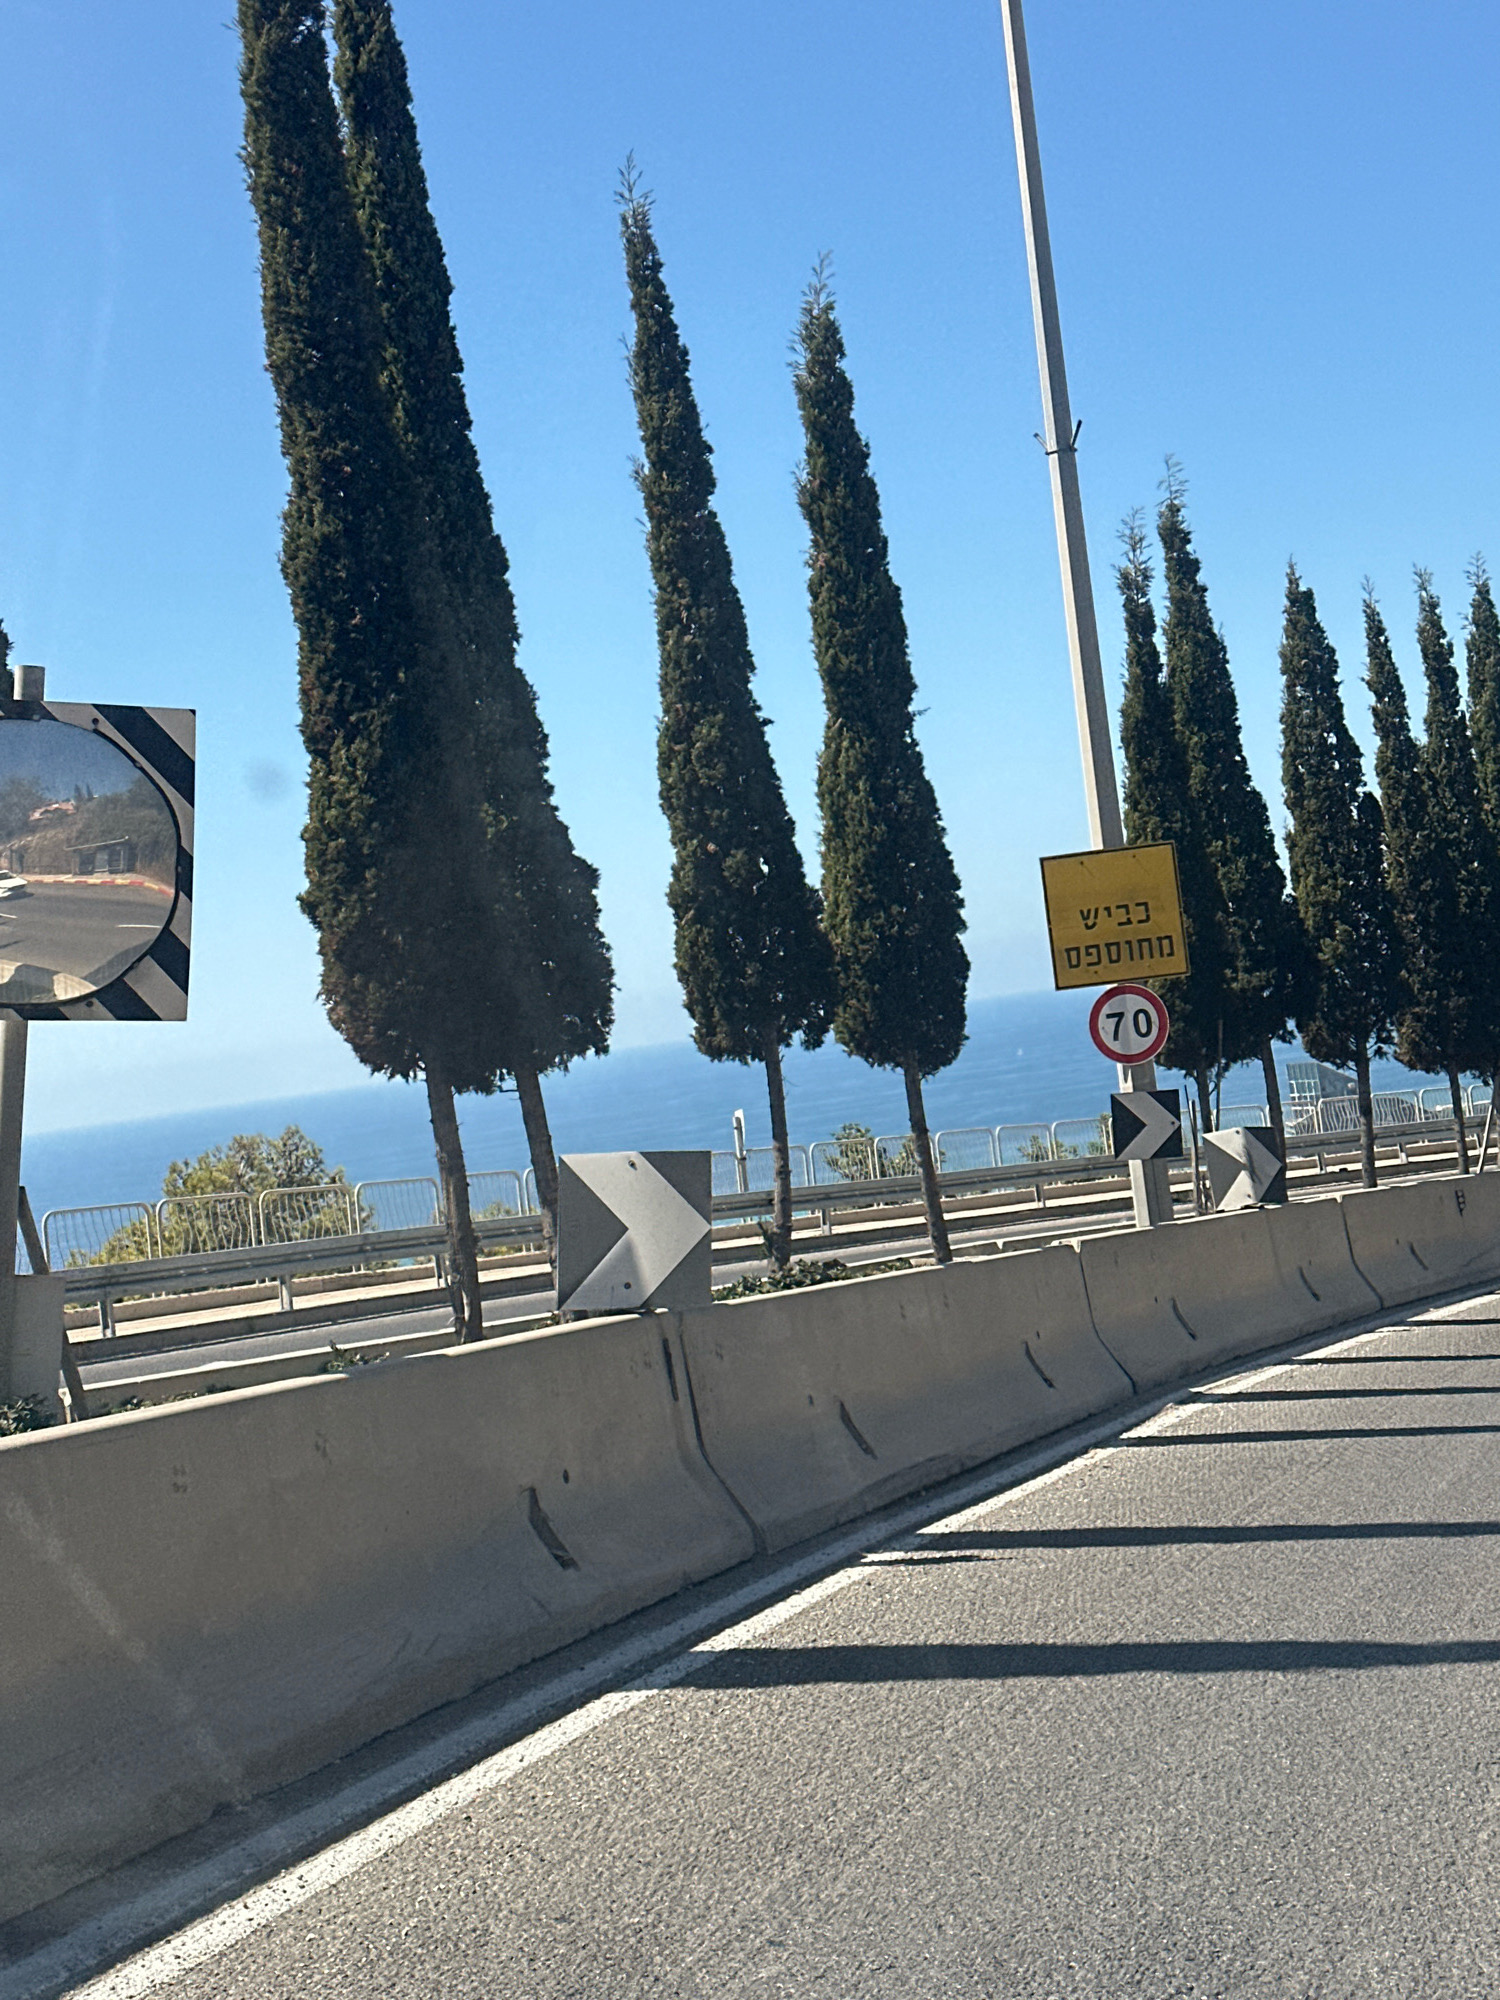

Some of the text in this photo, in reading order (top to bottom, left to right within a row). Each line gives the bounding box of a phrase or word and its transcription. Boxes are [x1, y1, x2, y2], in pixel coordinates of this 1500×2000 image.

[1079, 901, 1151, 930] כביש
[1064, 935, 1175, 969] מחוספס
[1105, 1008, 1153, 1042] 70
